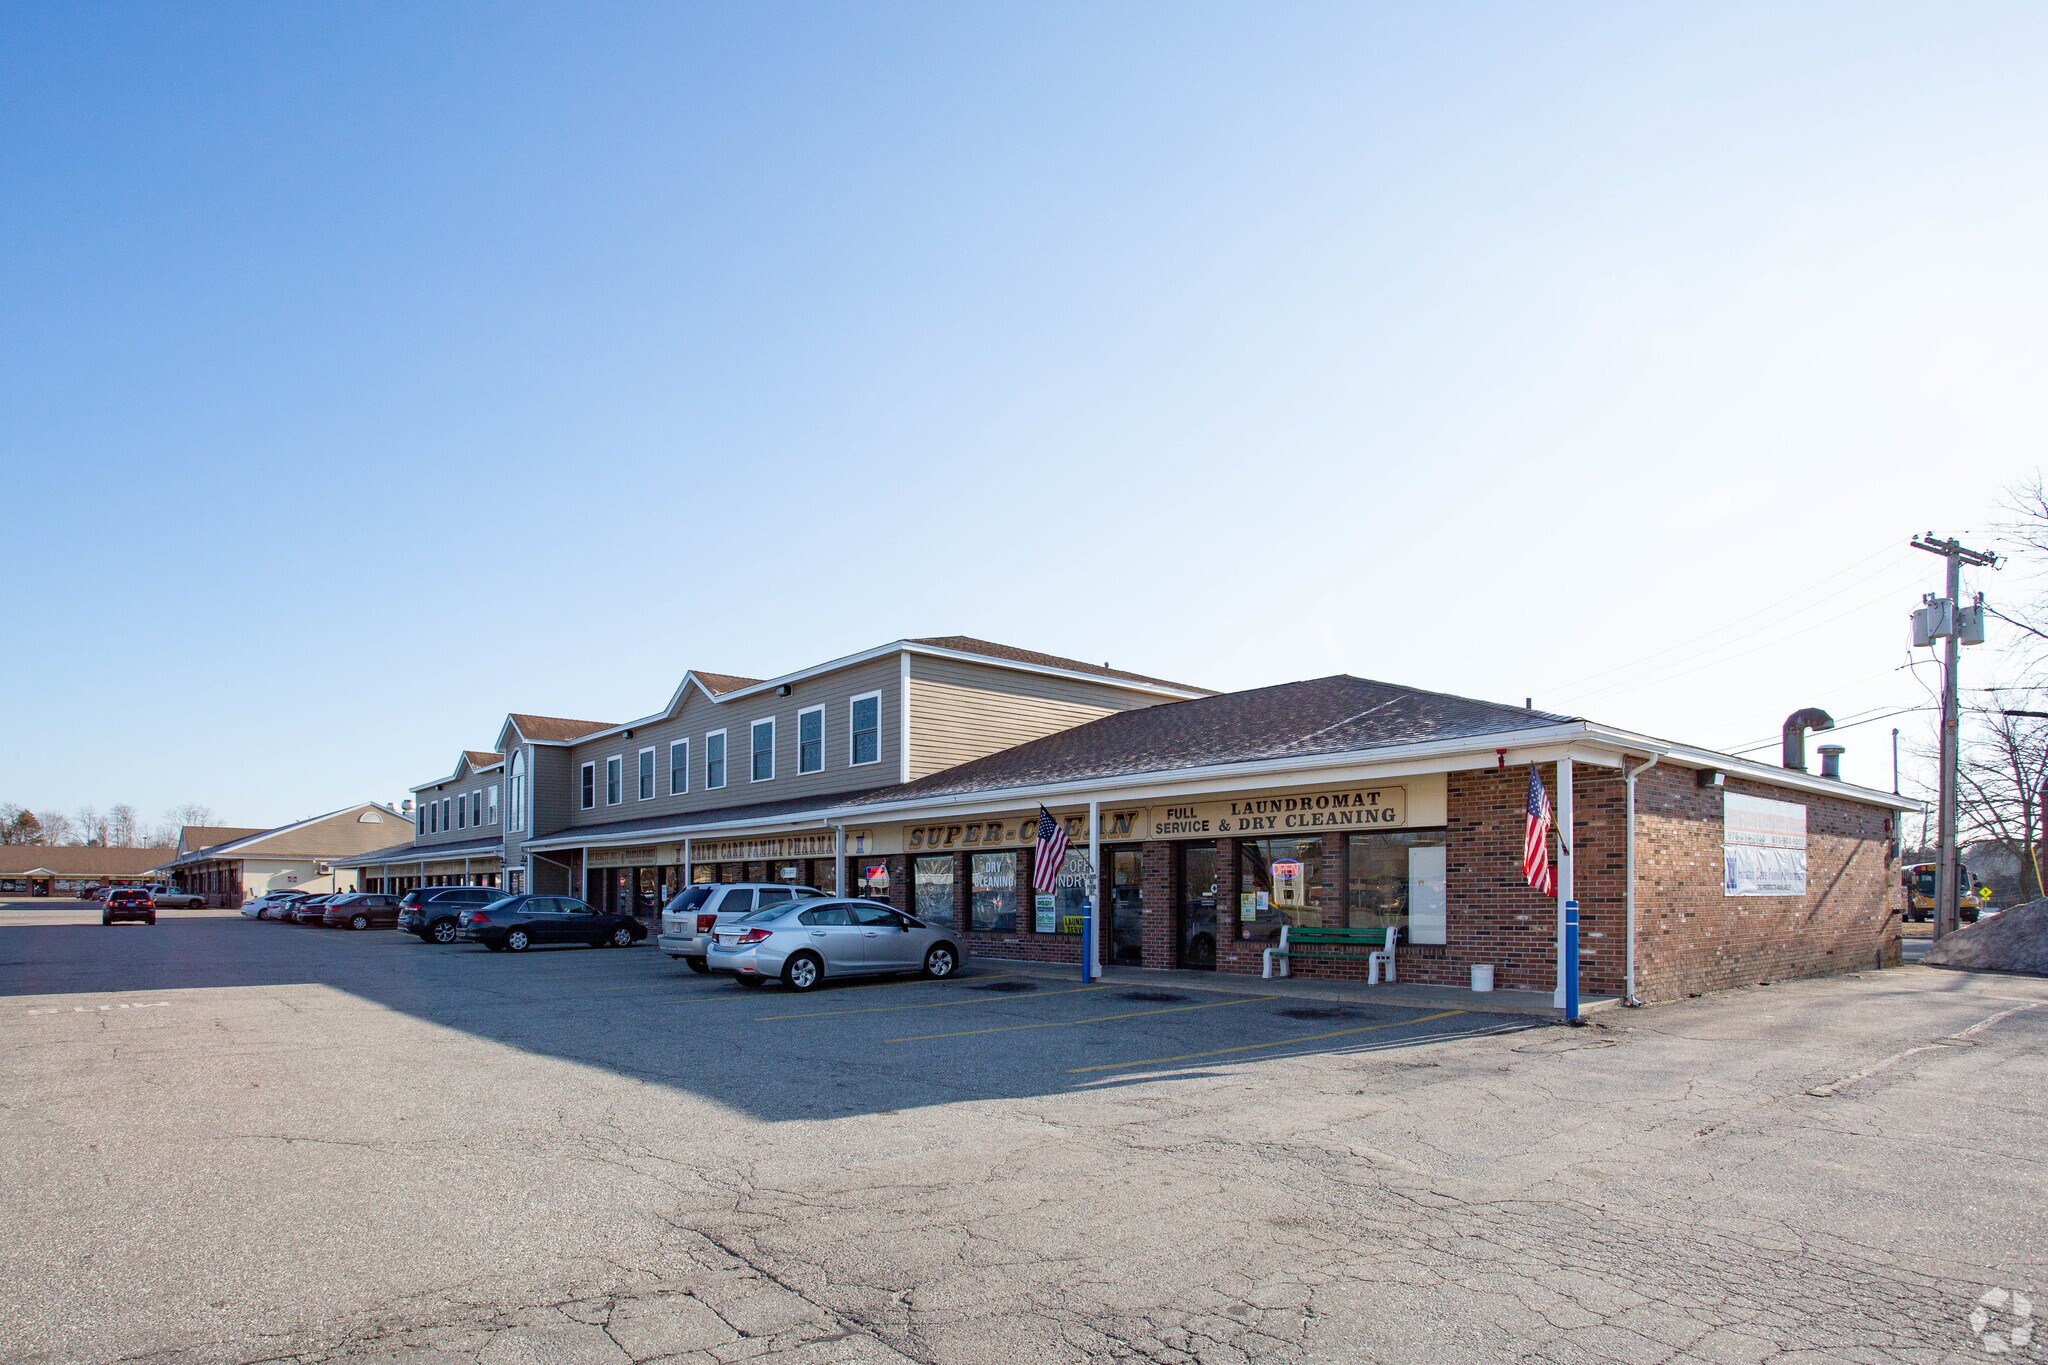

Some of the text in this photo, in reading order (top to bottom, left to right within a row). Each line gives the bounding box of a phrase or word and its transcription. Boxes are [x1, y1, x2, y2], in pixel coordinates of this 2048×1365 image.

[1167, 807, 1198, 819] FULL
[1231, 792, 1381, 816] LAUNDROMAT
[909, 811, 1139, 850] SUPER-CEAN
[1155, 819, 1210, 835] SERVICE
[1218, 808, 1397, 832] & DRY CLEANING
[691, 843, 718, 861] EALTH
[721, 840, 745, 860] CARE
[747, 838, 785, 859] FAMILY
[985, 861, 1002, 873] DRY
